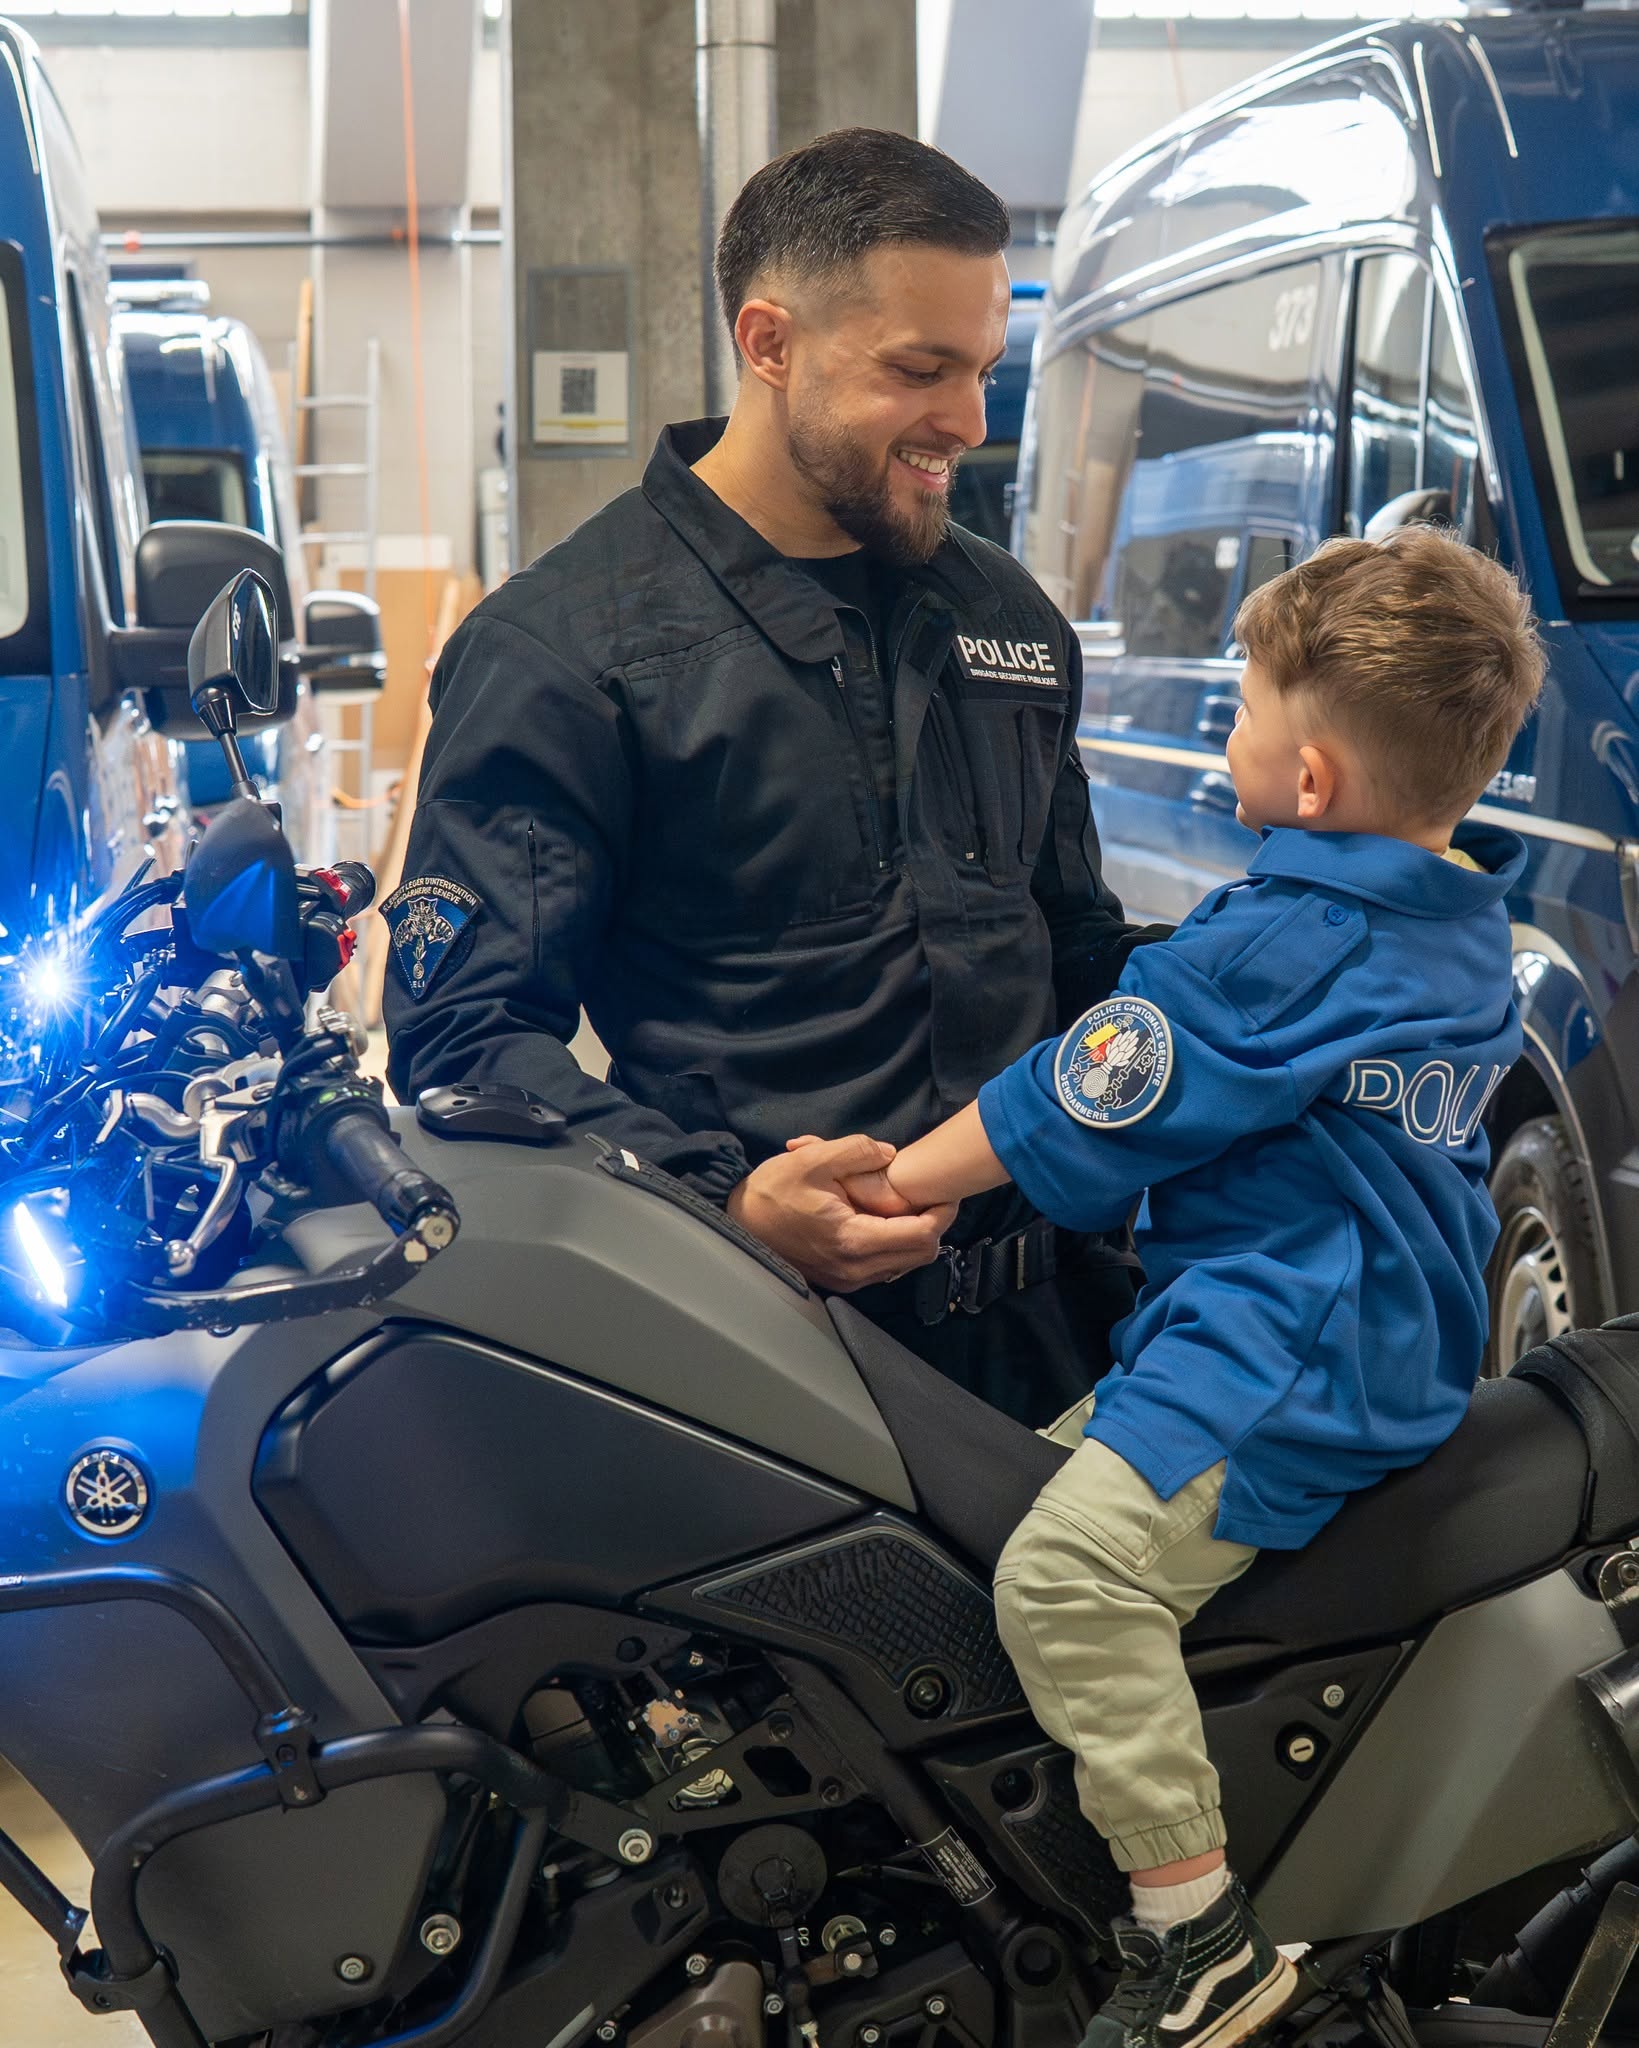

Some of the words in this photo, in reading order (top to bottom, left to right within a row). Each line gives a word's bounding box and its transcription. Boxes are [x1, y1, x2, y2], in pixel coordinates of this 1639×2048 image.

[957, 635, 1056, 672] POLICE
[969, 668, 999, 679] BRIGADE
[1026, 675, 1059, 686] PUBLIQUE
[432, 887, 462, 905] GENEVE
[1086, 1003, 1122, 1025] POLICE
[1123, 1003, 1165, 1039] CANTONALE
[1152, 1041, 1167, 1087] GENEVE
[1060, 1073, 1109, 1121] GENDARMERIE
